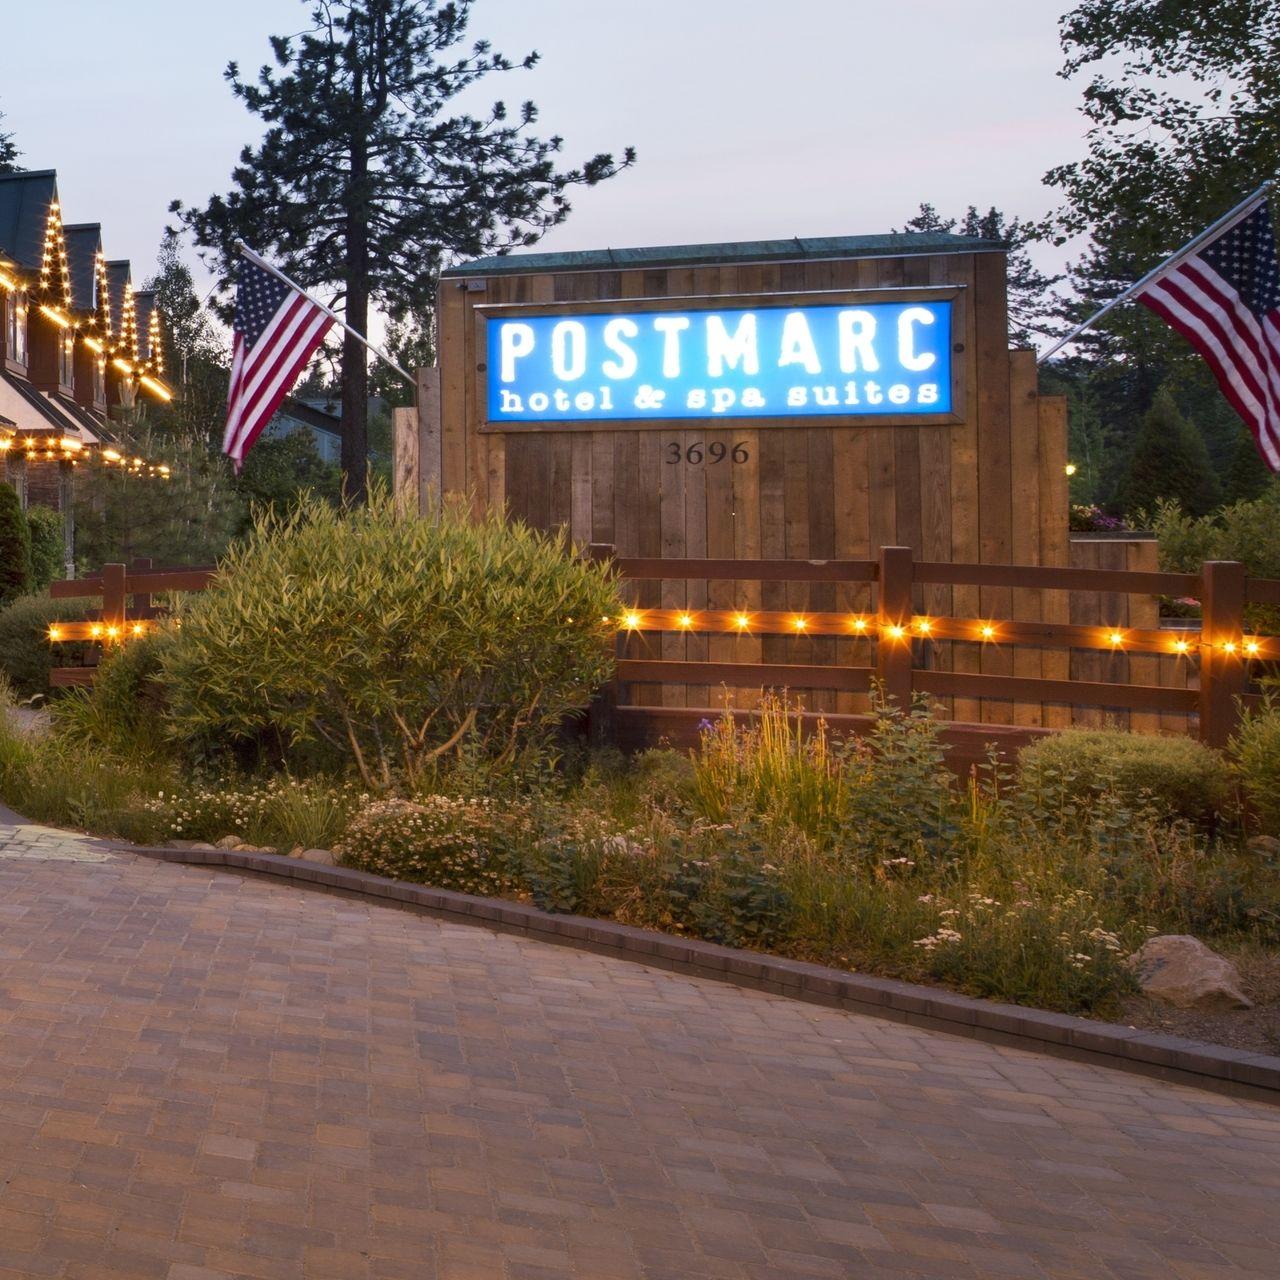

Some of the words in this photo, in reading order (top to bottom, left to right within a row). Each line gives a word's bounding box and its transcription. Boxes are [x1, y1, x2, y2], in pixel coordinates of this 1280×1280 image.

[500, 307, 936, 383] POSTMARC
[500, 385, 614, 413] hotel
[634, 384, 664, 410] &
[686, 384, 766, 413] spa
[786, 381, 939, 407] suites
[665, 441, 751, 466] 3696
